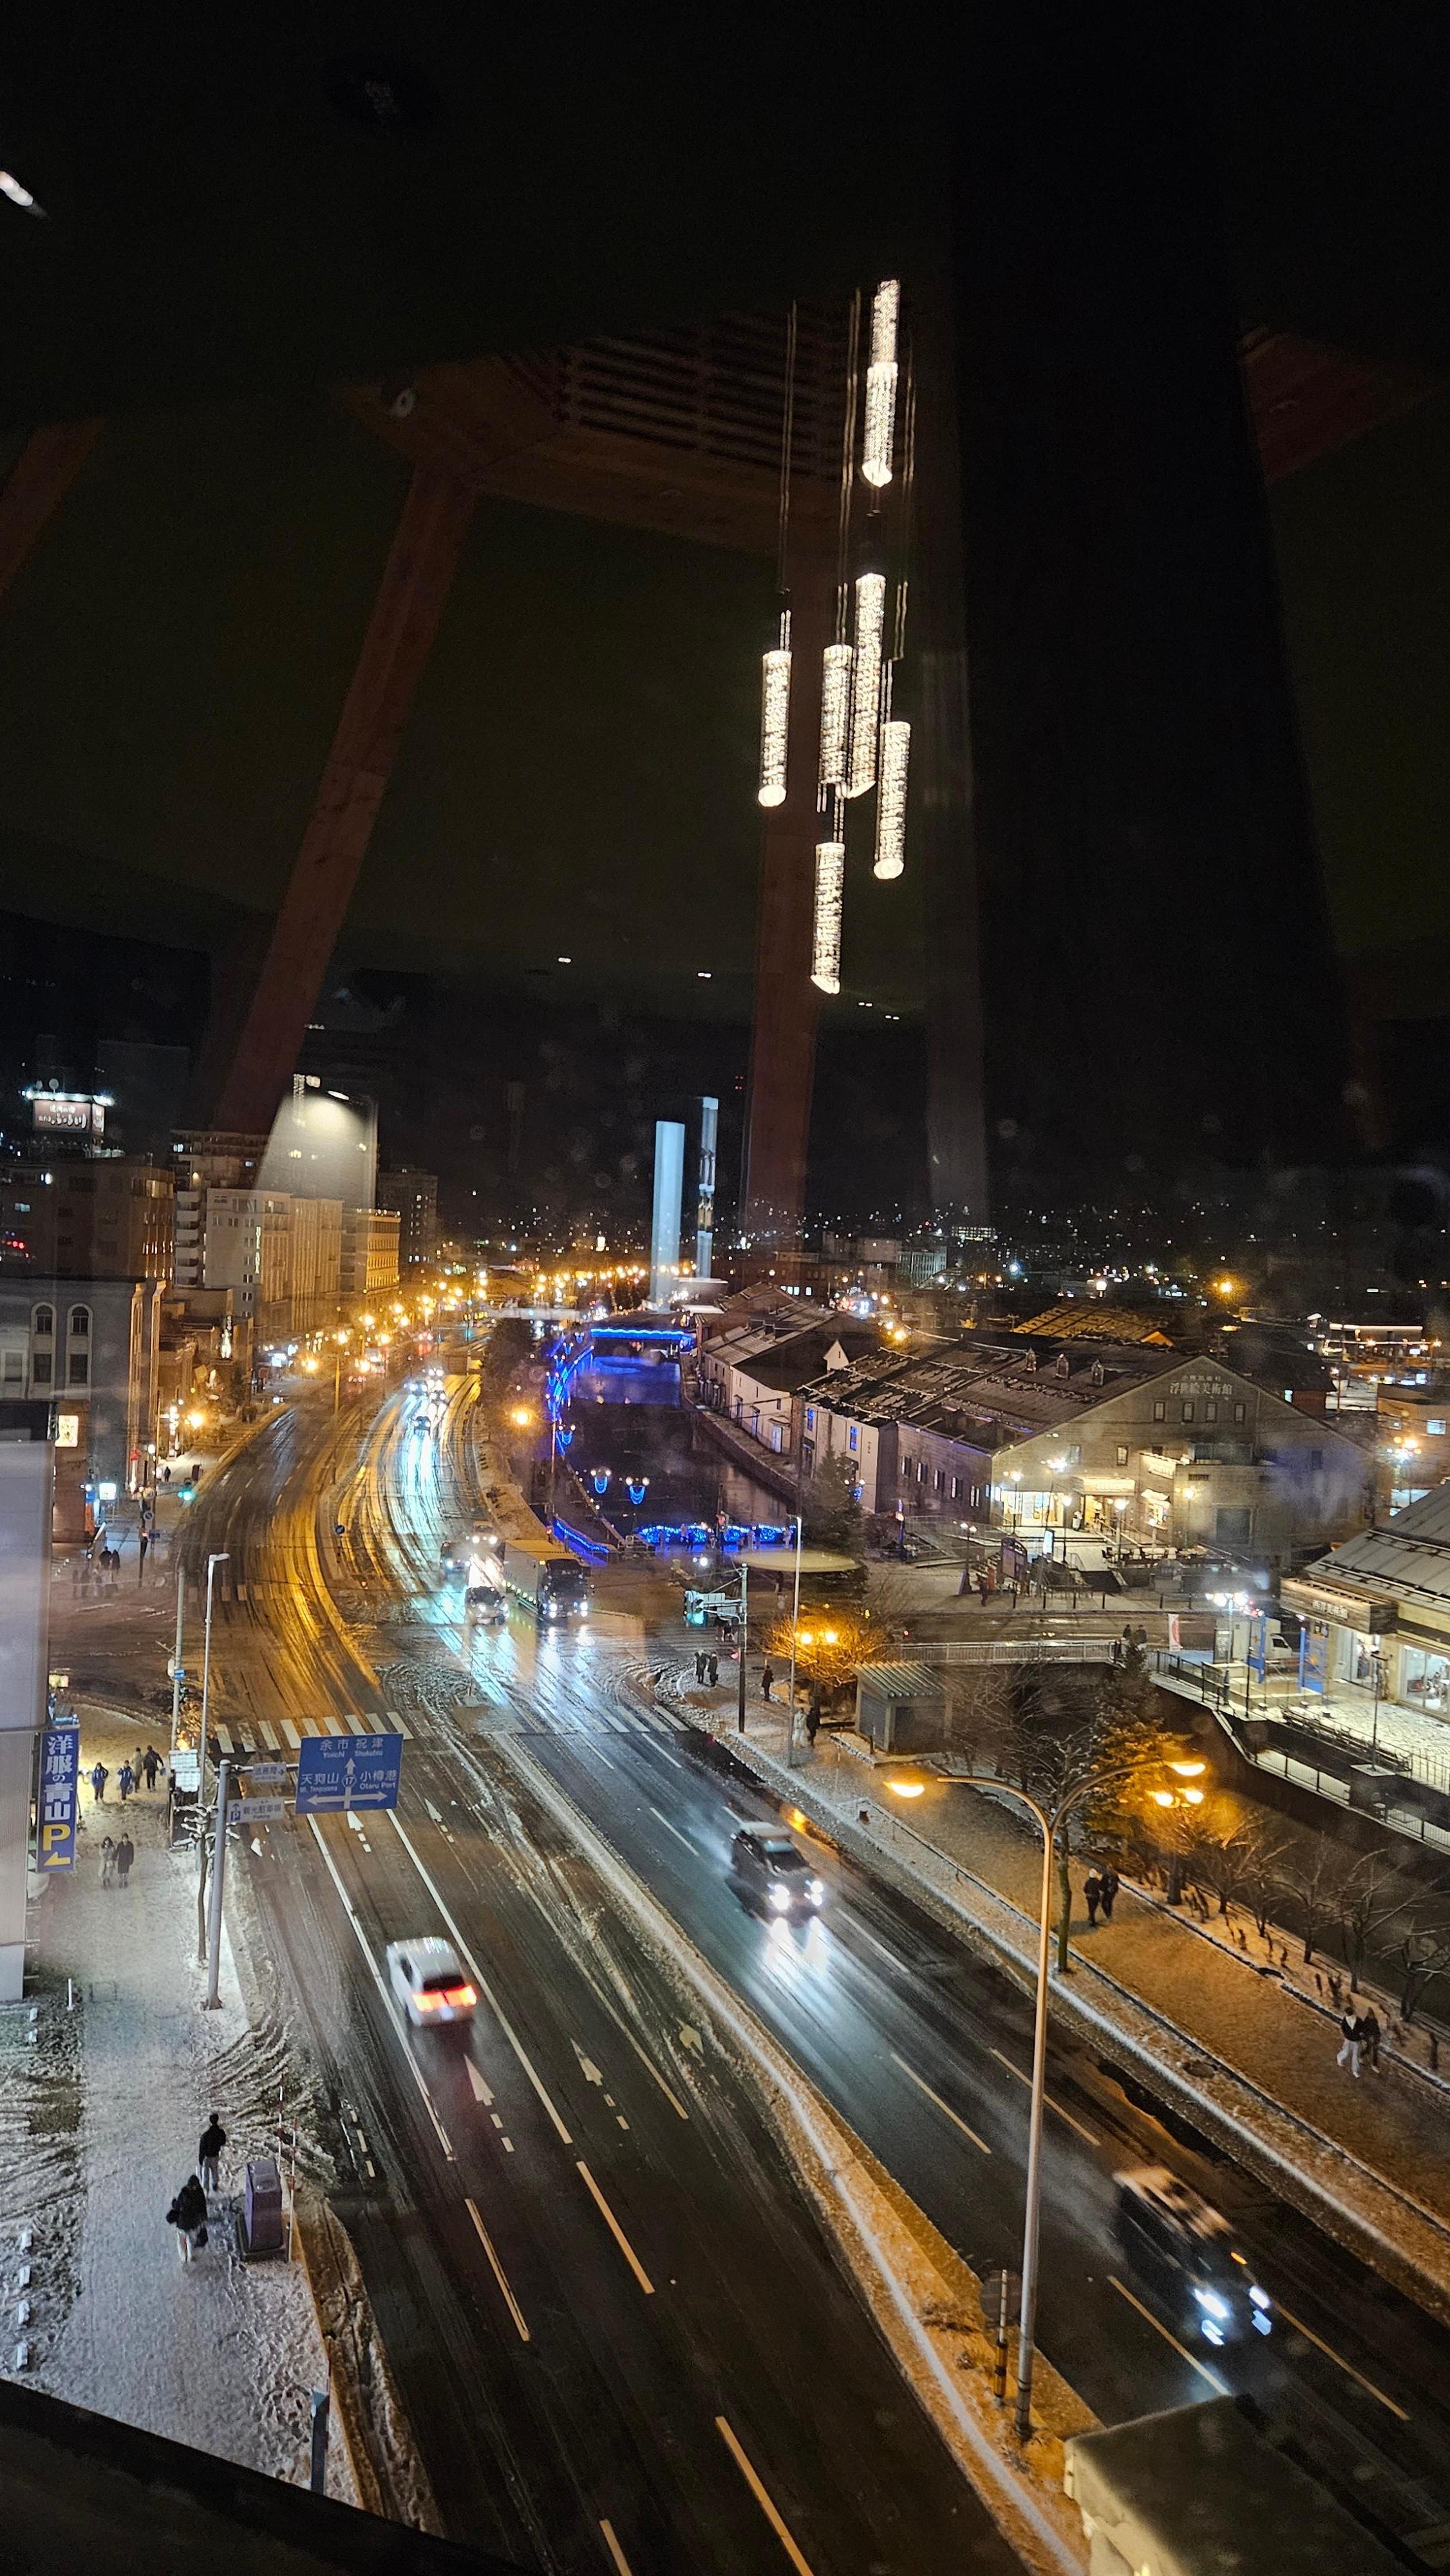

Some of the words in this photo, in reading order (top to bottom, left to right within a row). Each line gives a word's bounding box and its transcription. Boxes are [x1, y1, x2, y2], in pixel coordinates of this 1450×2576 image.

[320, 1739, 348, 1750] 余市
[355, 1738, 384, 1749] 祝津
[44, 1735, 73, 1821] 洋服の青山
[300, 1772, 339, 1785] 天狗山
[360, 1770, 397, 1782] 小樽港
[42, 1824, 70, 1851] P
